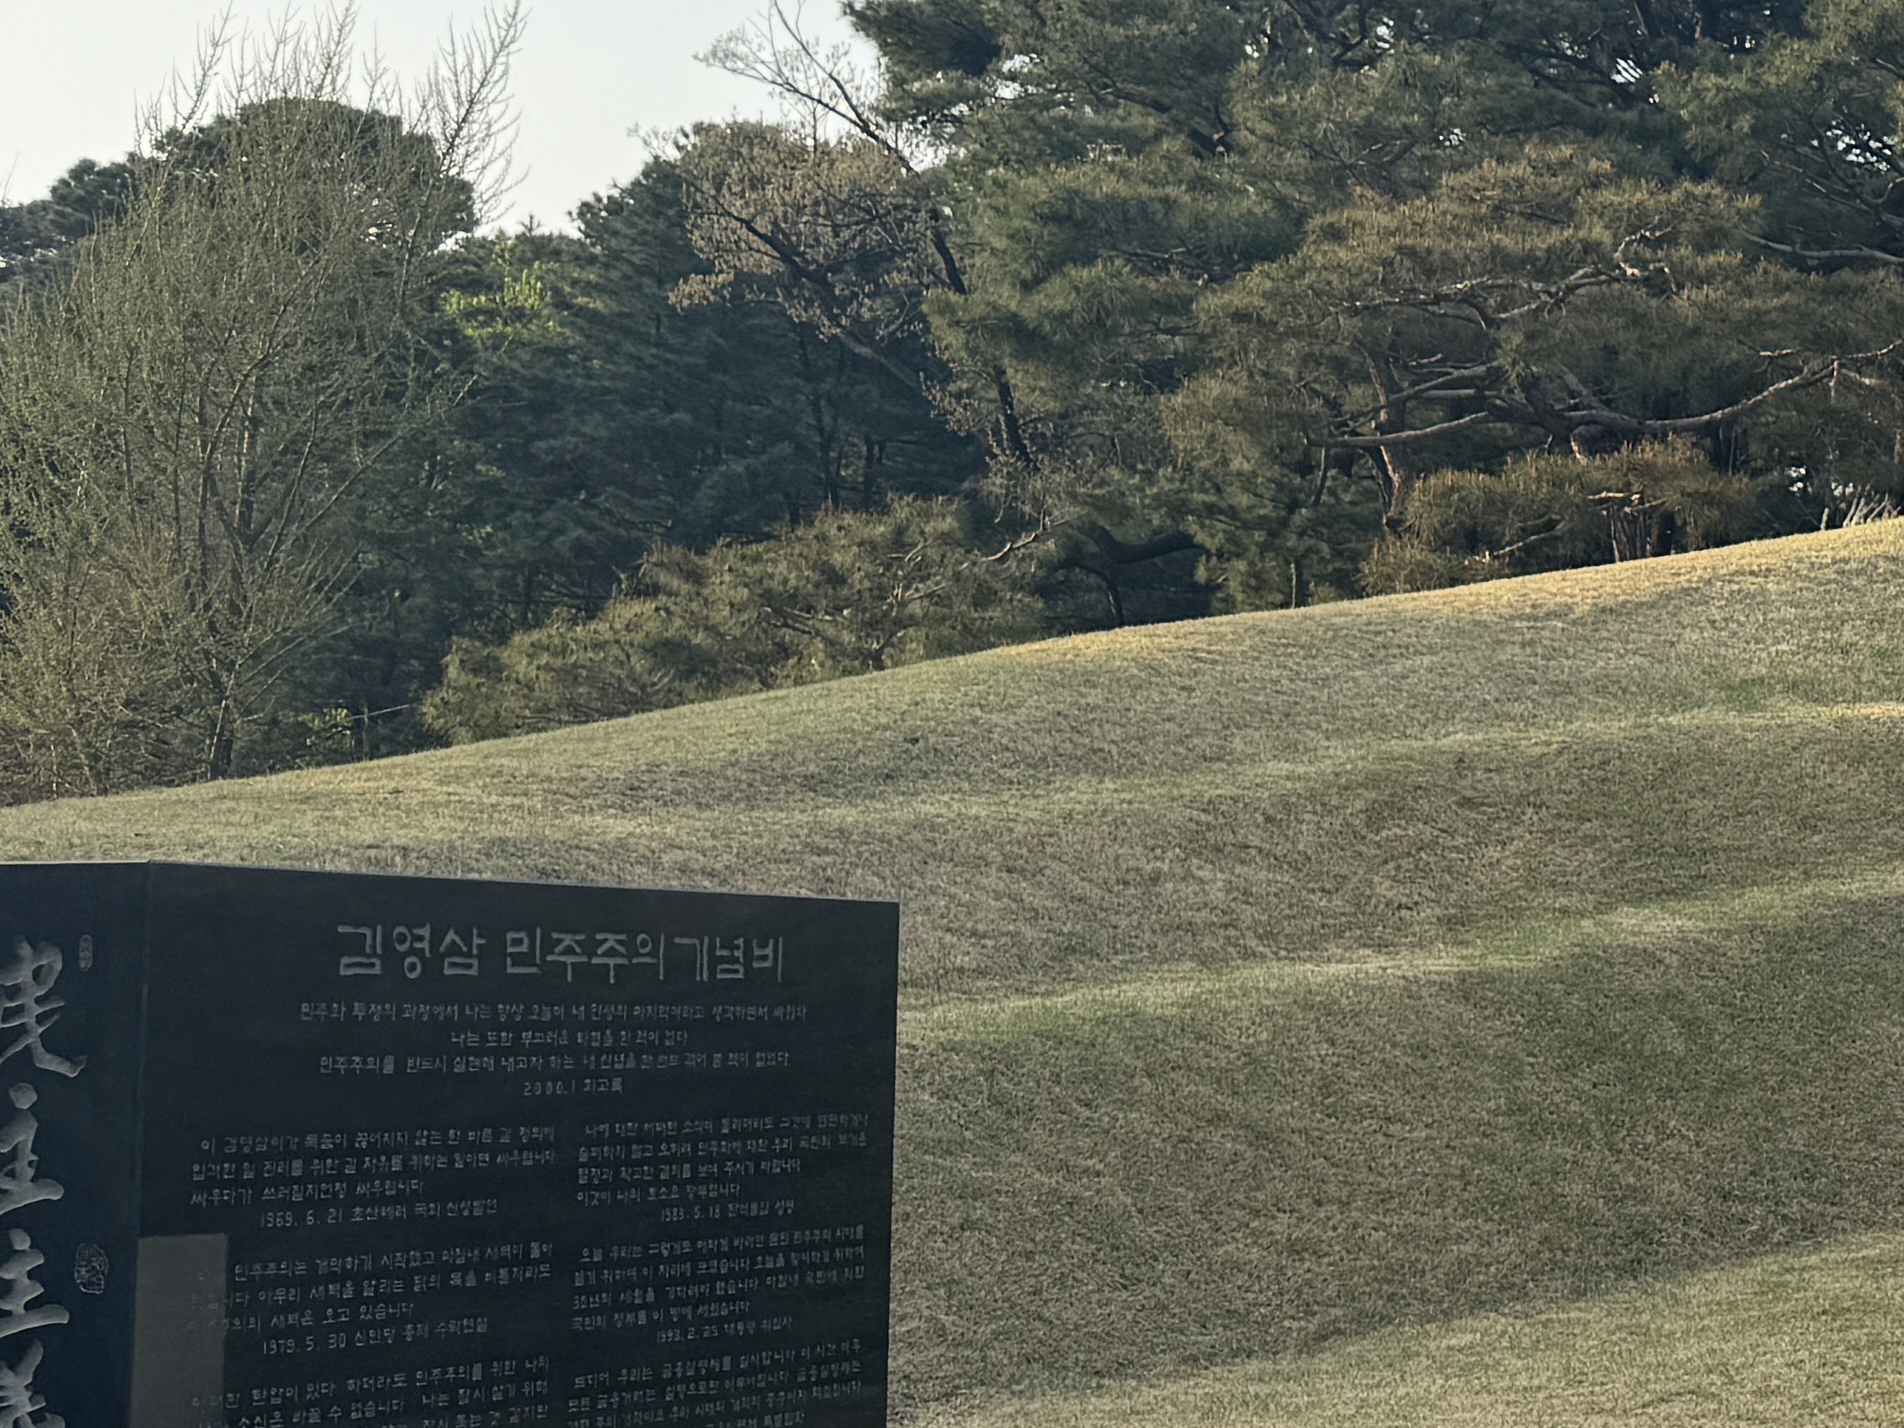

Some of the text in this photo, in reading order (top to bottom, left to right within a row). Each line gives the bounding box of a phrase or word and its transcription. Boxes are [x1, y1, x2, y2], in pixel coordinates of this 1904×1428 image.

[337, 923, 487, 979] 김영삼
[301, 1002, 346, 1022] 민주화
[352, 1002, 396, 1022] 투쟁의
[401, 1003, 458, 1021] 과정에서
[465, 1004, 491, 1021] 나는
[498, 1004, 524, 1021] 항상
[591, 1003, 627, 1021] 인생의
[451, 1031, 479, 1048] 나는
[486, 1031, 512, 1047] 또한
[320, 1055, 395, 1075] 민주주의를
[406, 1055, 446, 1073] 반드시
[201, 1137, 215, 1156] 이
[224, 1135, 299, 1154] 김영삼이가
[264, 1159, 303, 1177] 진리를
[190, 1188, 252, 1207] 싸우다가
[327, 1208, 343, 1224] 21
[235, 1260, 307, 1281] 민주주의는
[258, 1287, 300, 1304] 아무리
[309, 1280, 354, 1300] 새벽을
[270, 1303, 414, 1329] 새벽은 오고 있습니다
[264, 1339, 300, 1355] 1979.
[328, 1332, 346, 1349] 30
[355, 1328, 395, 1346] 신민당
[307, 1381, 335, 1400] 있다
[416, 1363, 482, 1386] 민주주의를
[328, 1405, 342, 1422] 수
[422, 1394, 449, 1408] 나는
